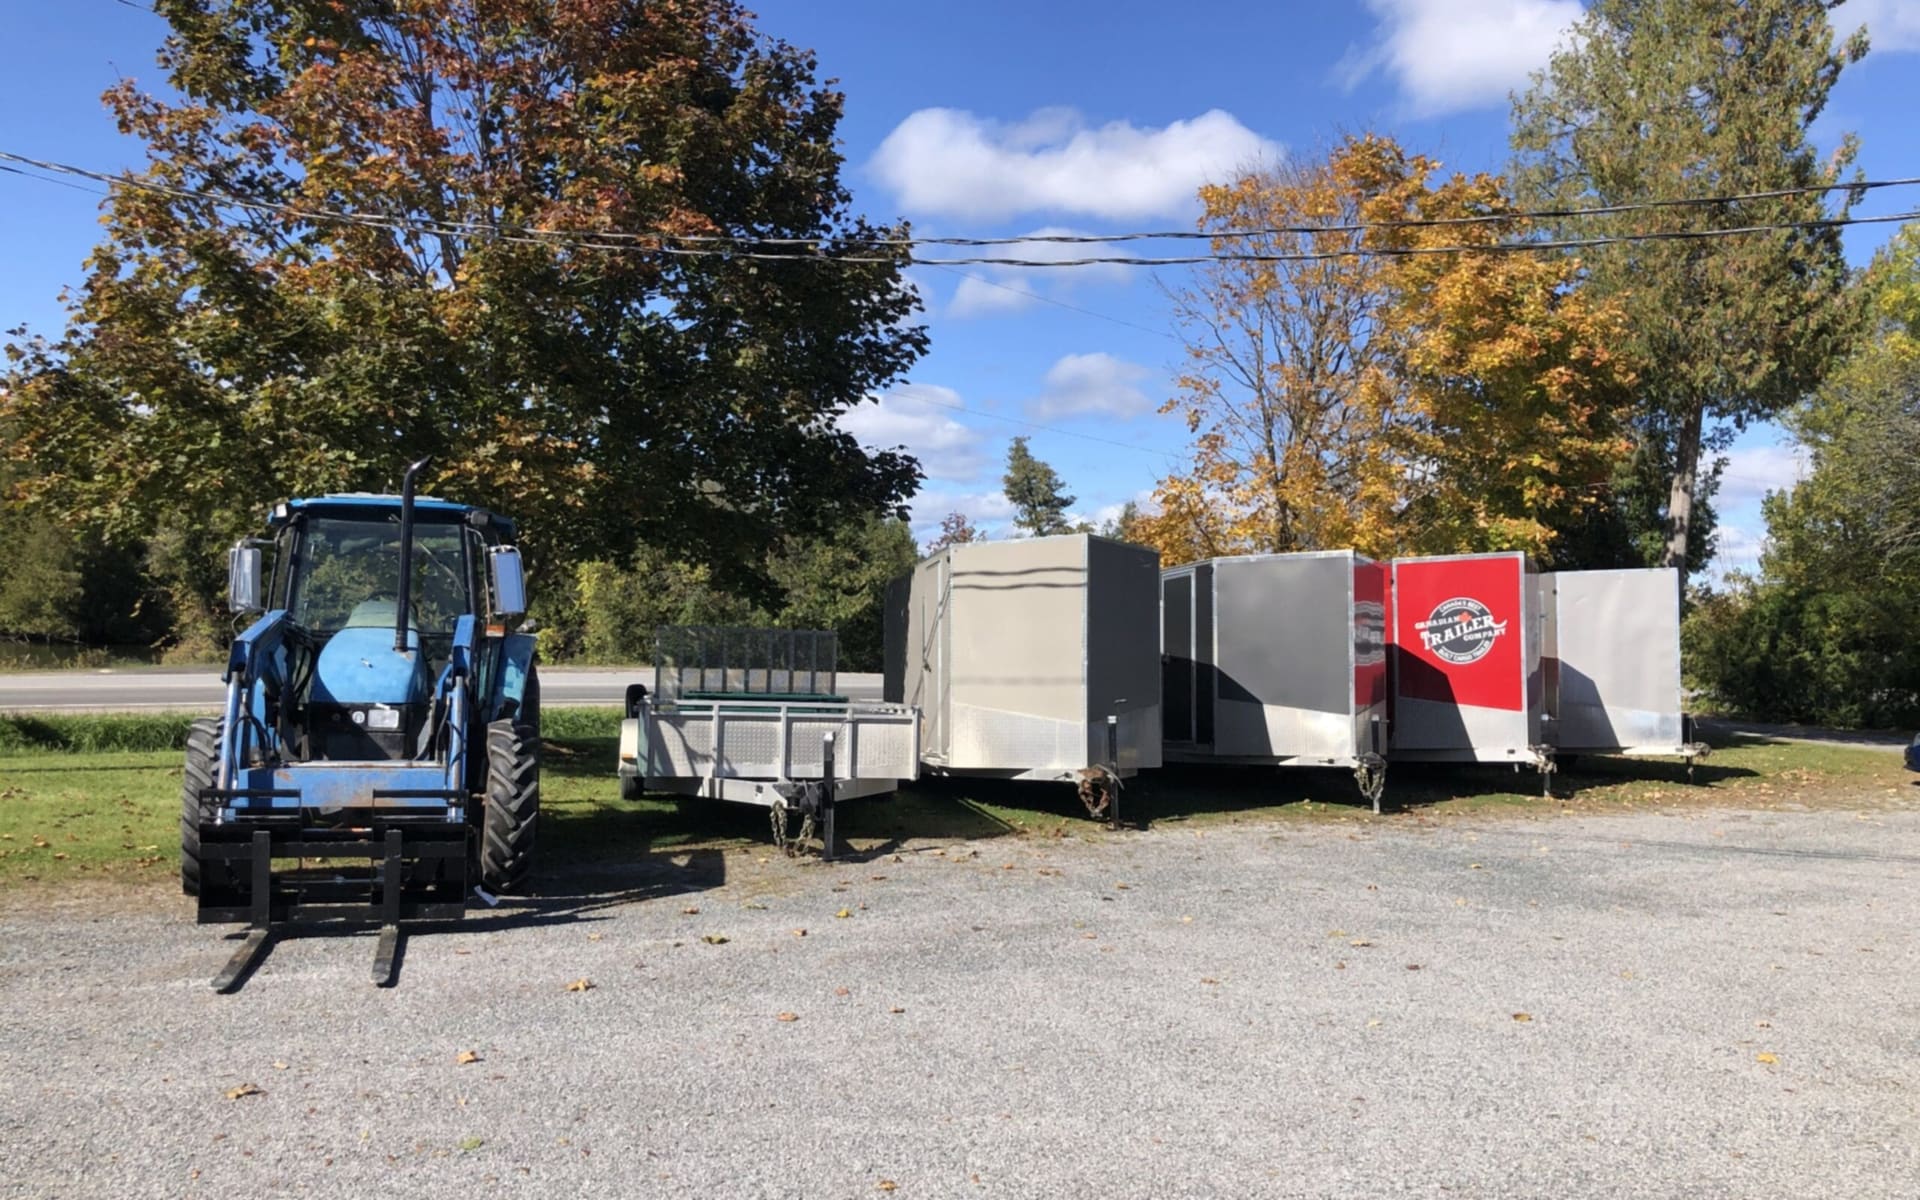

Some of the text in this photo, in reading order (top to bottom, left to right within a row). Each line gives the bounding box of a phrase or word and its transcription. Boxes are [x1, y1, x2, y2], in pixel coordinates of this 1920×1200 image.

[1414, 616, 1459, 629] CANADIAN
[1420, 615, 1507, 650] TRAILER
[1463, 628, 1506, 641] COMPANY
